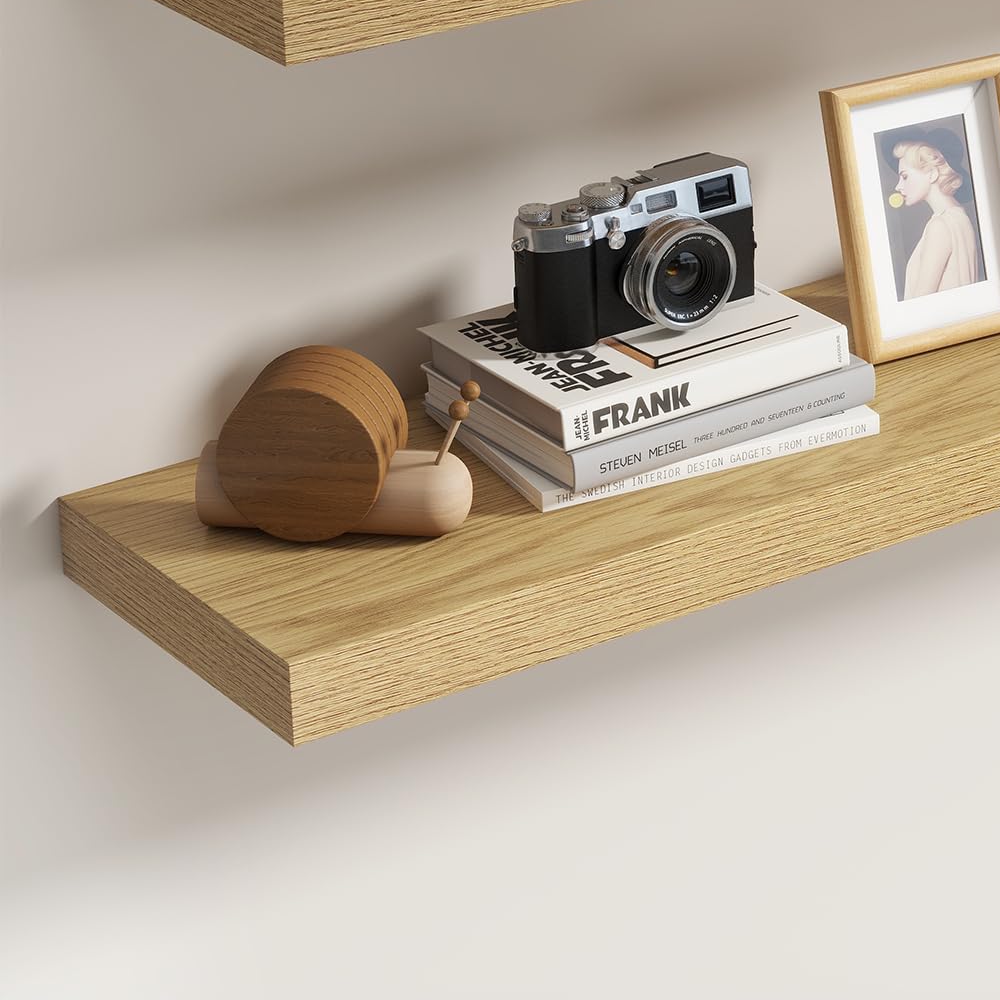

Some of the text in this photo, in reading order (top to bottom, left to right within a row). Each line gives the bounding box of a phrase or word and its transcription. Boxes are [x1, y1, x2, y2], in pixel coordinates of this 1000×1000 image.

[582, 409, 590, 441] MICHEL
[592, 381, 692, 435] FRANK
[556, 423, 867, 505] THE SWEDISH INTERIOR DESIGN GADGETS FROM EVERMOTION
[599, 452, 642, 474] STEVEN
[648, 439, 688, 459] MEISEL
[694, 432, 714, 444] THREE
[717, 422, 748, 437] HUNDRED
[751, 416, 765, 426] AND
[768, 405, 804, 422] SEVENTEEN
